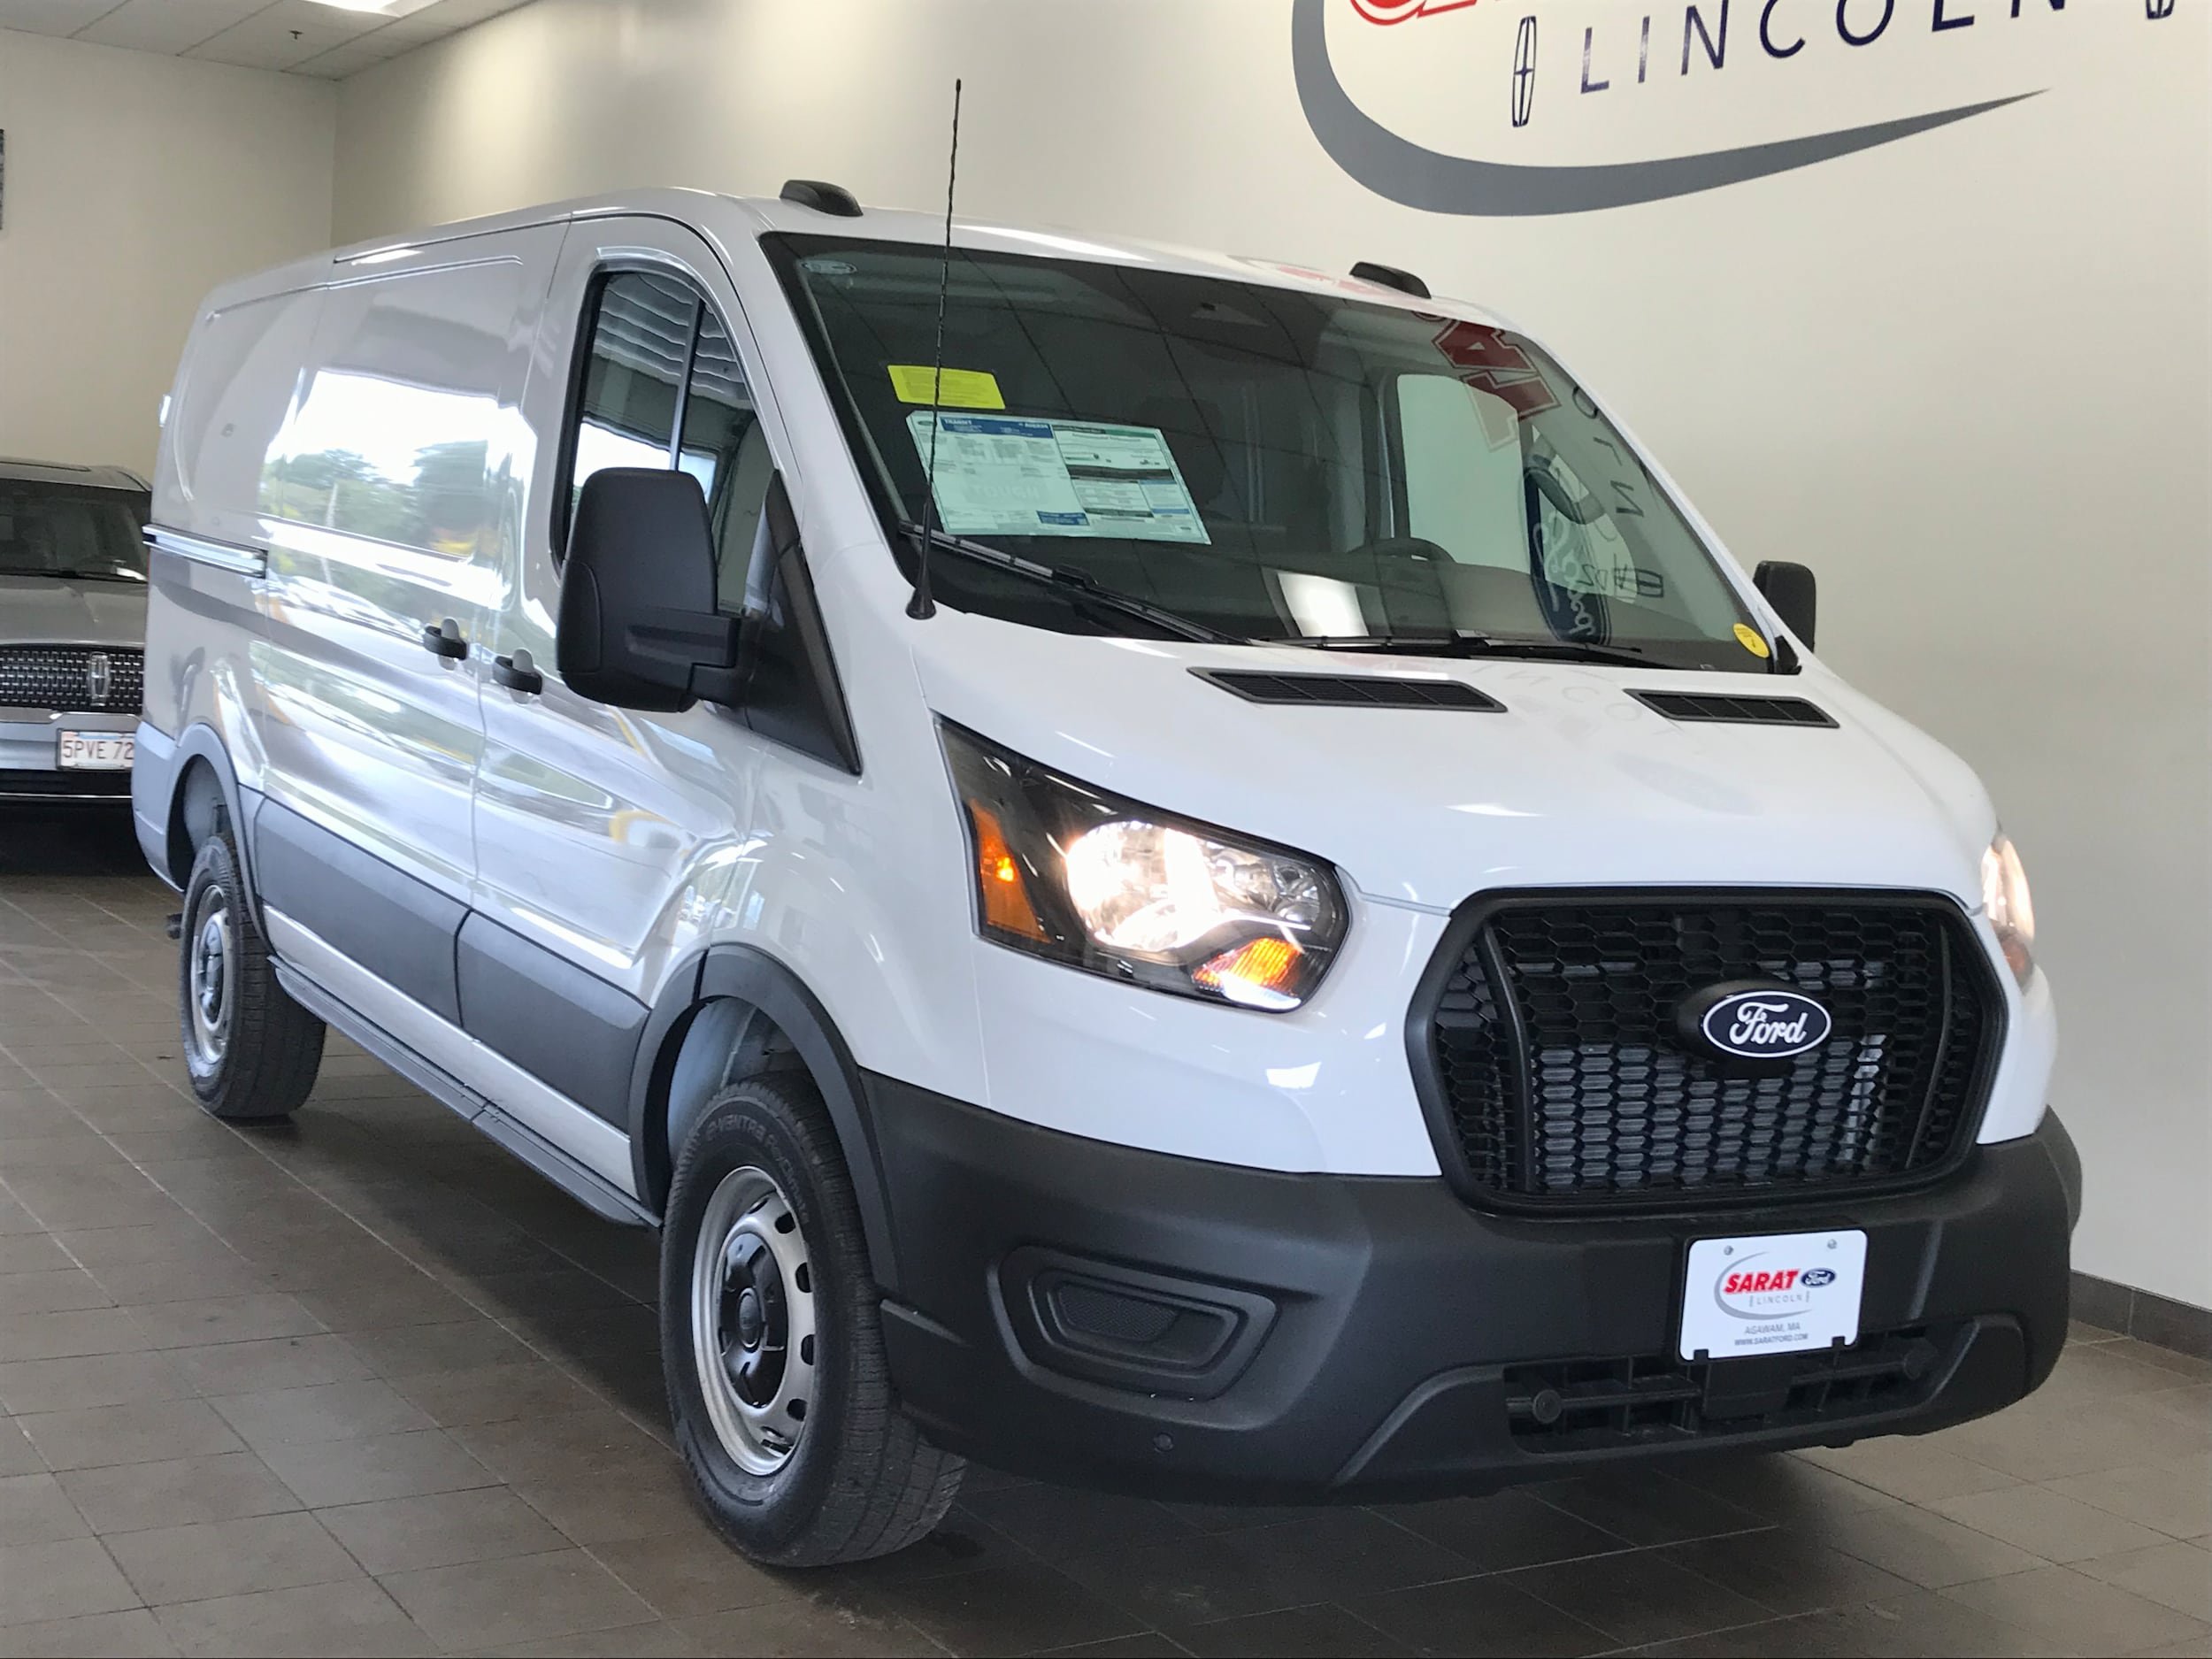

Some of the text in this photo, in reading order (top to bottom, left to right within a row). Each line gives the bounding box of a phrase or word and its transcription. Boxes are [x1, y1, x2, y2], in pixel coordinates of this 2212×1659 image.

[1580, 0, 2066, 94] LINCOL
[63, 740, 107, 759] 5PVE
[1729, 1002, 1809, 1045] Ford
[1724, 1269, 1800, 1294] SARAT
[1756, 1294, 1802, 1305] LINCOLN
[1787, 1322, 1801, 1331] MA
